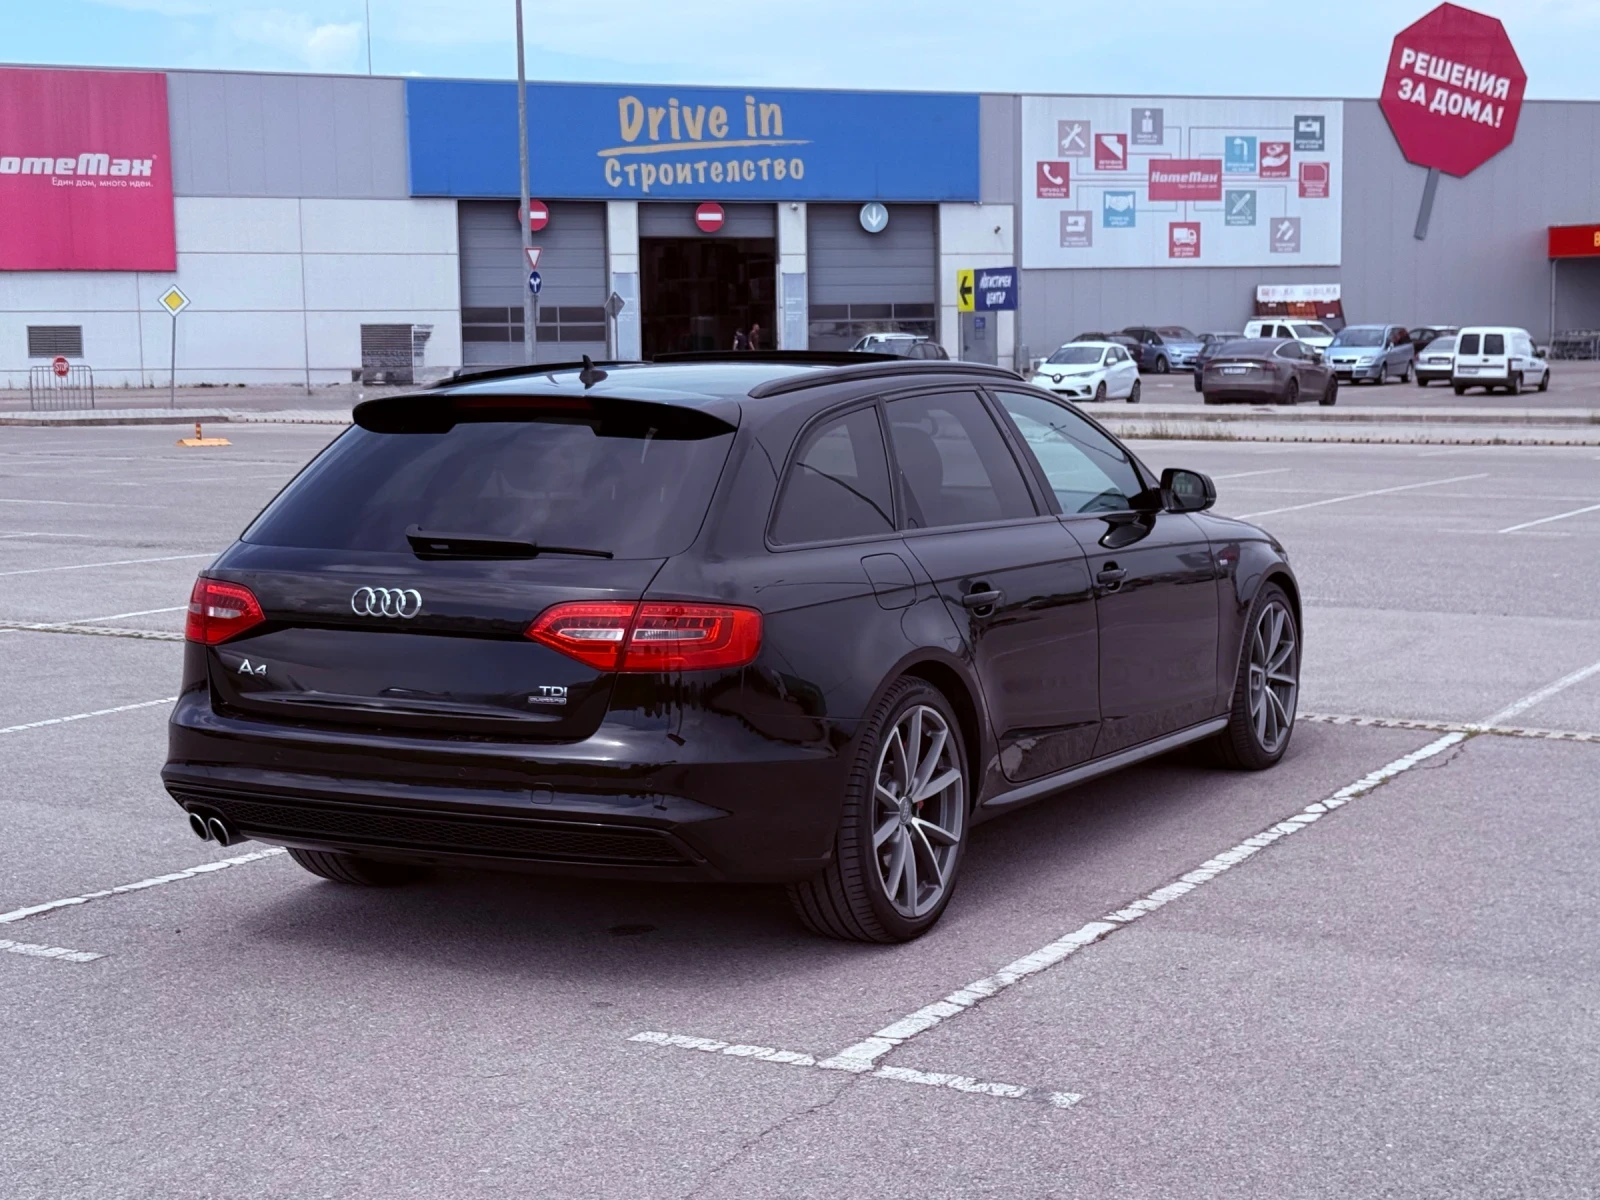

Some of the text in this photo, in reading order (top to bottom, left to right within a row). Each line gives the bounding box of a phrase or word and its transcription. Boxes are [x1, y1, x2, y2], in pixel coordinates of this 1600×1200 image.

[1399, 47, 1510, 100] РЕШЕНИЯ
[1397, 78, 1505, 128] ЗА ДОМА!
[618, 95, 784, 142] Drive in
[0, 153, 153, 176] omeMax
[52, 177, 74, 187] Един
[100, 180, 127, 188] много
[605, 157, 805, 193] Строителство
[1151, 171, 1219, 183] HomeMax
[54, 362, 69, 371] STOP
[237, 658, 267, 675] A4
[538, 685, 568, 697] TDI
